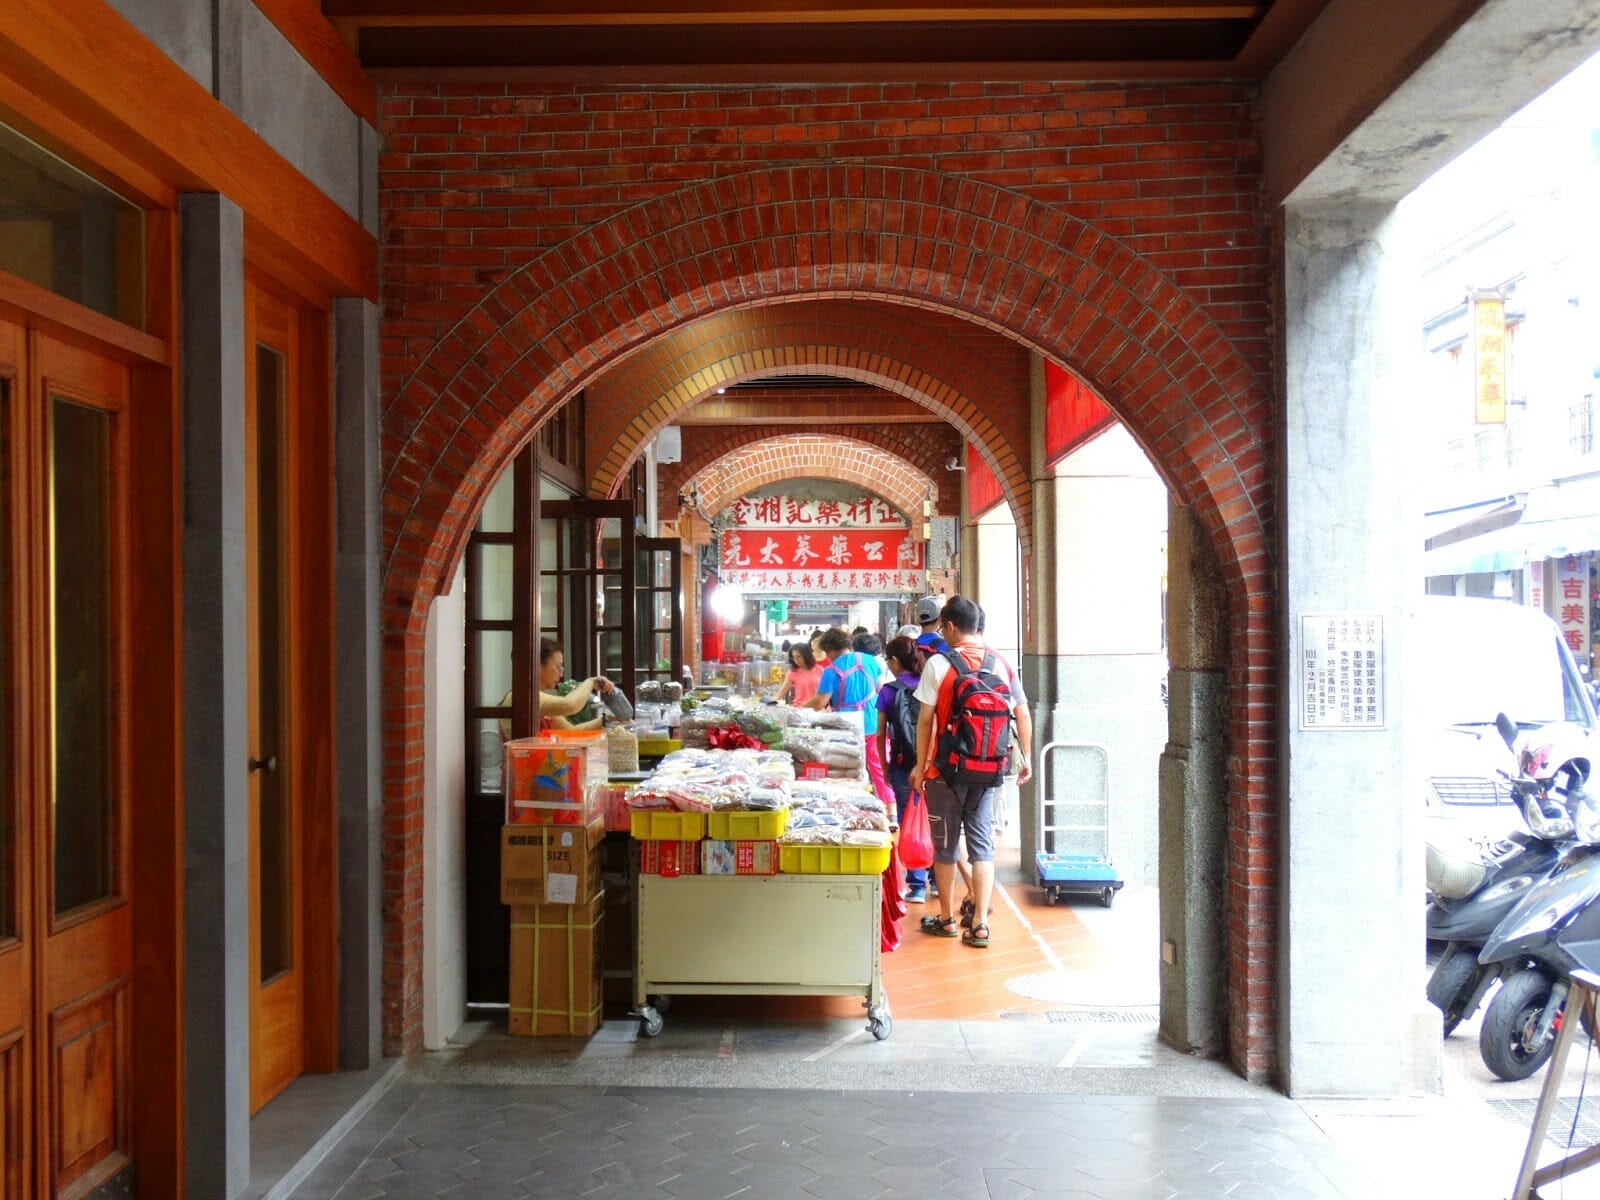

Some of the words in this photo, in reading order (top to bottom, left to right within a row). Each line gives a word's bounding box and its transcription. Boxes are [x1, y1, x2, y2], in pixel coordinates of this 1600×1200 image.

[1561, 577, 1585, 652] 吉美香
[546, 851, 571, 861] SIZE
